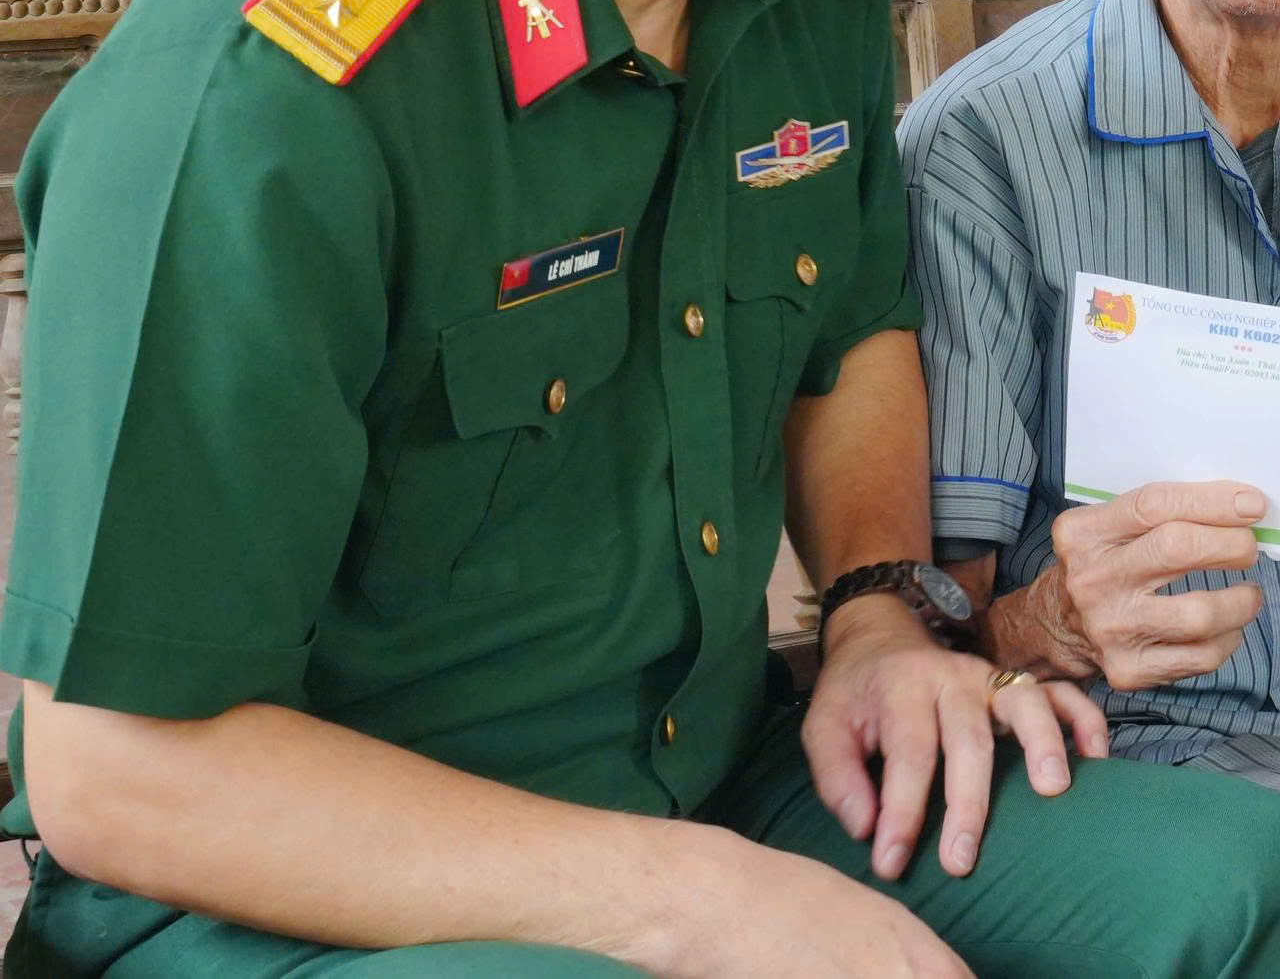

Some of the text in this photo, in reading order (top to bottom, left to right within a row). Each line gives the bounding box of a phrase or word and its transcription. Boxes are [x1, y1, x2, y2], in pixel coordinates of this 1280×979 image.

[547, 260, 559, 281] LÊ
[1141, 295, 1172, 313] TỔNG
[1174, 303, 1198, 318] CỤC
[1199, 307, 1233, 323] CÔNG
[1208, 323, 1280, 345] KHO K602
